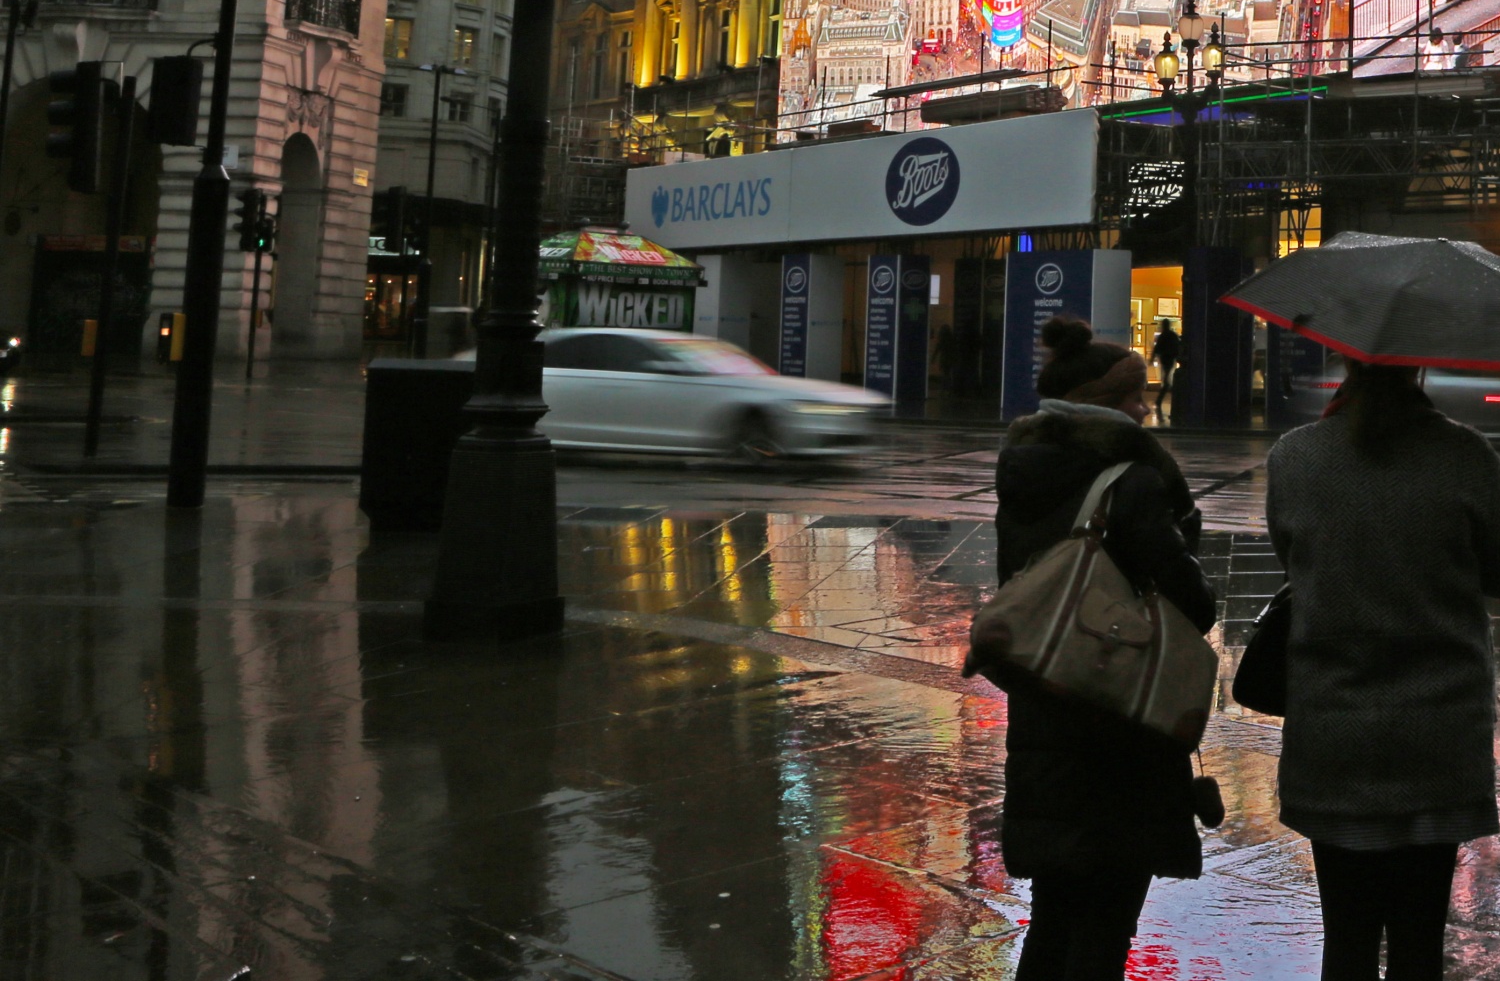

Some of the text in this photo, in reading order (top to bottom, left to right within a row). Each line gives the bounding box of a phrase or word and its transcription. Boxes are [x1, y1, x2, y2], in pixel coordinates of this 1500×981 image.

[893, 151, 949, 209] Boots
[671, 177, 772, 221] BARCLAYS
[597, 245, 666, 263] WICKED
[607, 265, 627, 274] BEST
[628, 266, 654, 276] SHOW
[655, 267, 664, 276] IN
[577, 284, 684, 328] WICKED
[1034, 297, 1063, 308] welcome
